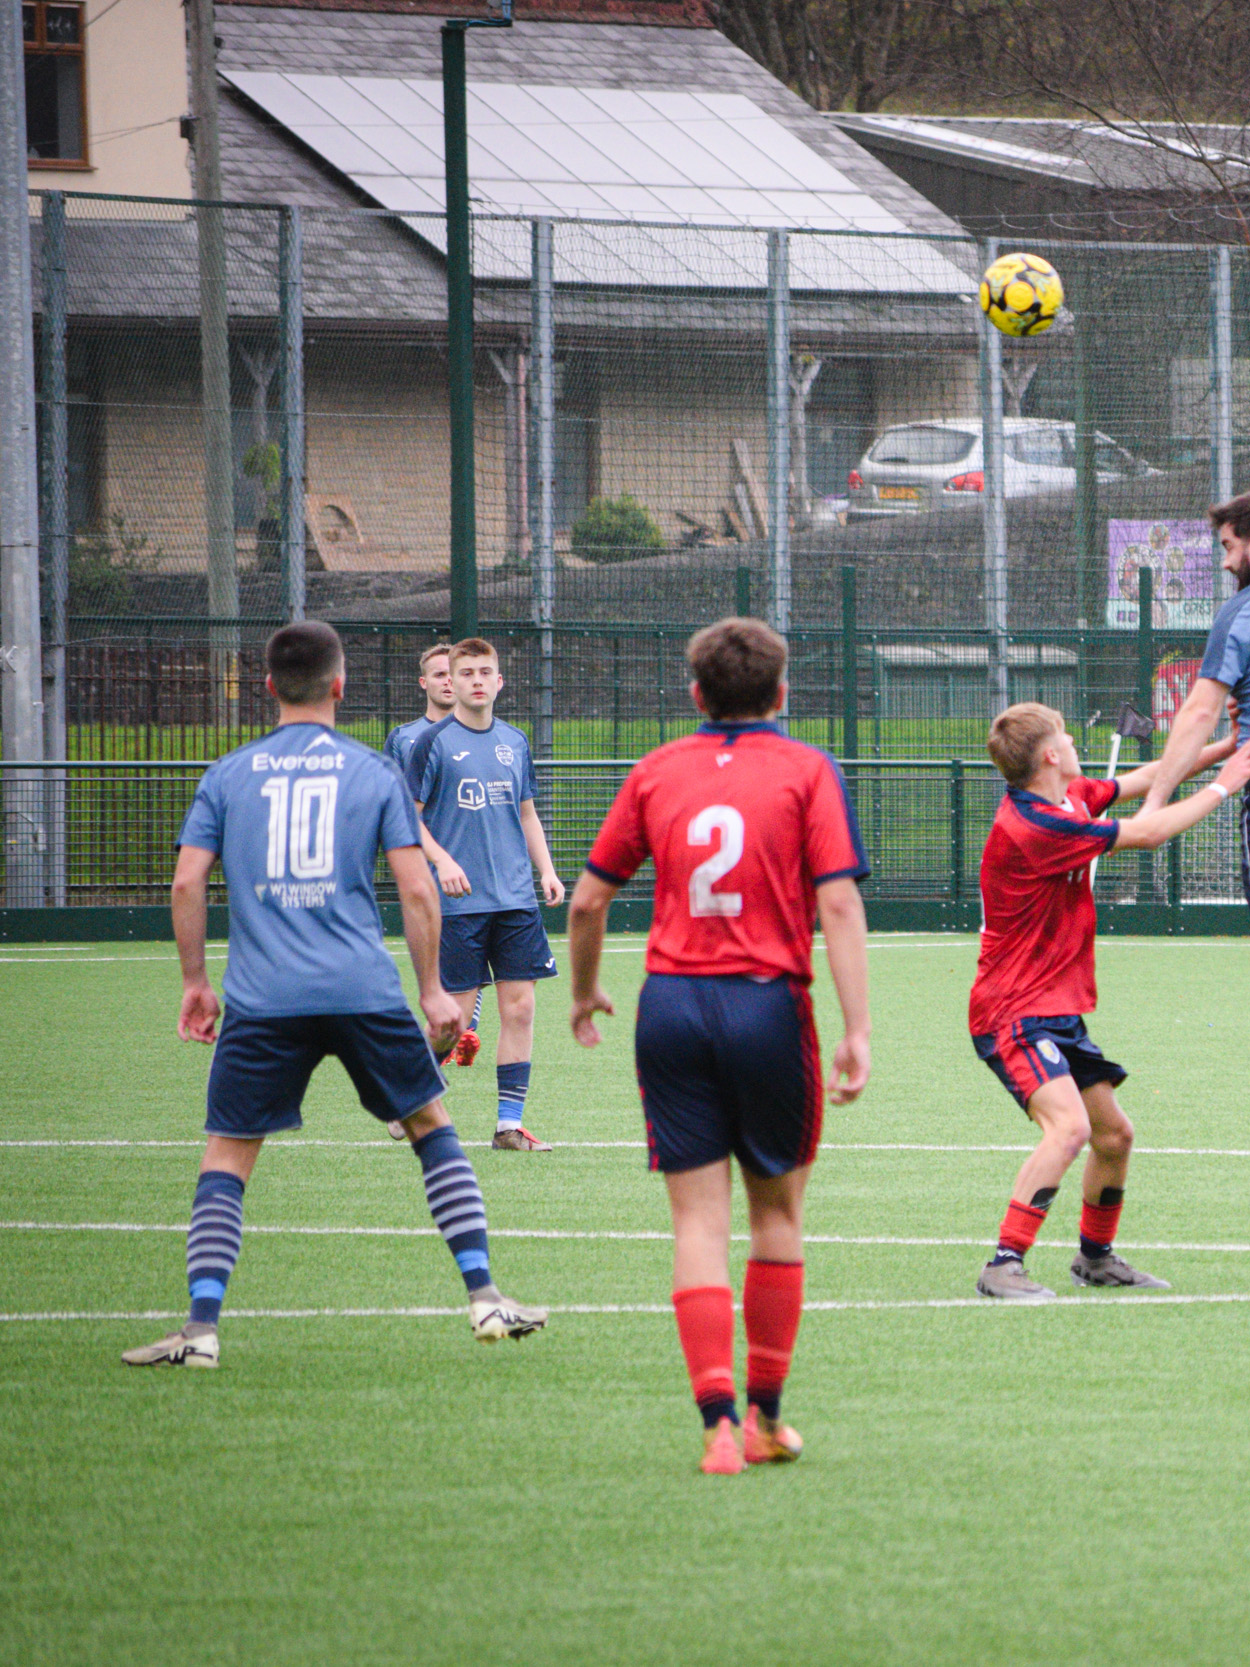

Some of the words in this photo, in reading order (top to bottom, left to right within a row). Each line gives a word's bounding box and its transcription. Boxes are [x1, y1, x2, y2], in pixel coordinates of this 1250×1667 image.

[252, 752, 346, 772] Everest
[261, 775, 339, 879] 10
[687, 804, 744, 917] 2
[289, 881, 337, 896] WINDOW
[282, 894, 325, 908] SYSTEMS
